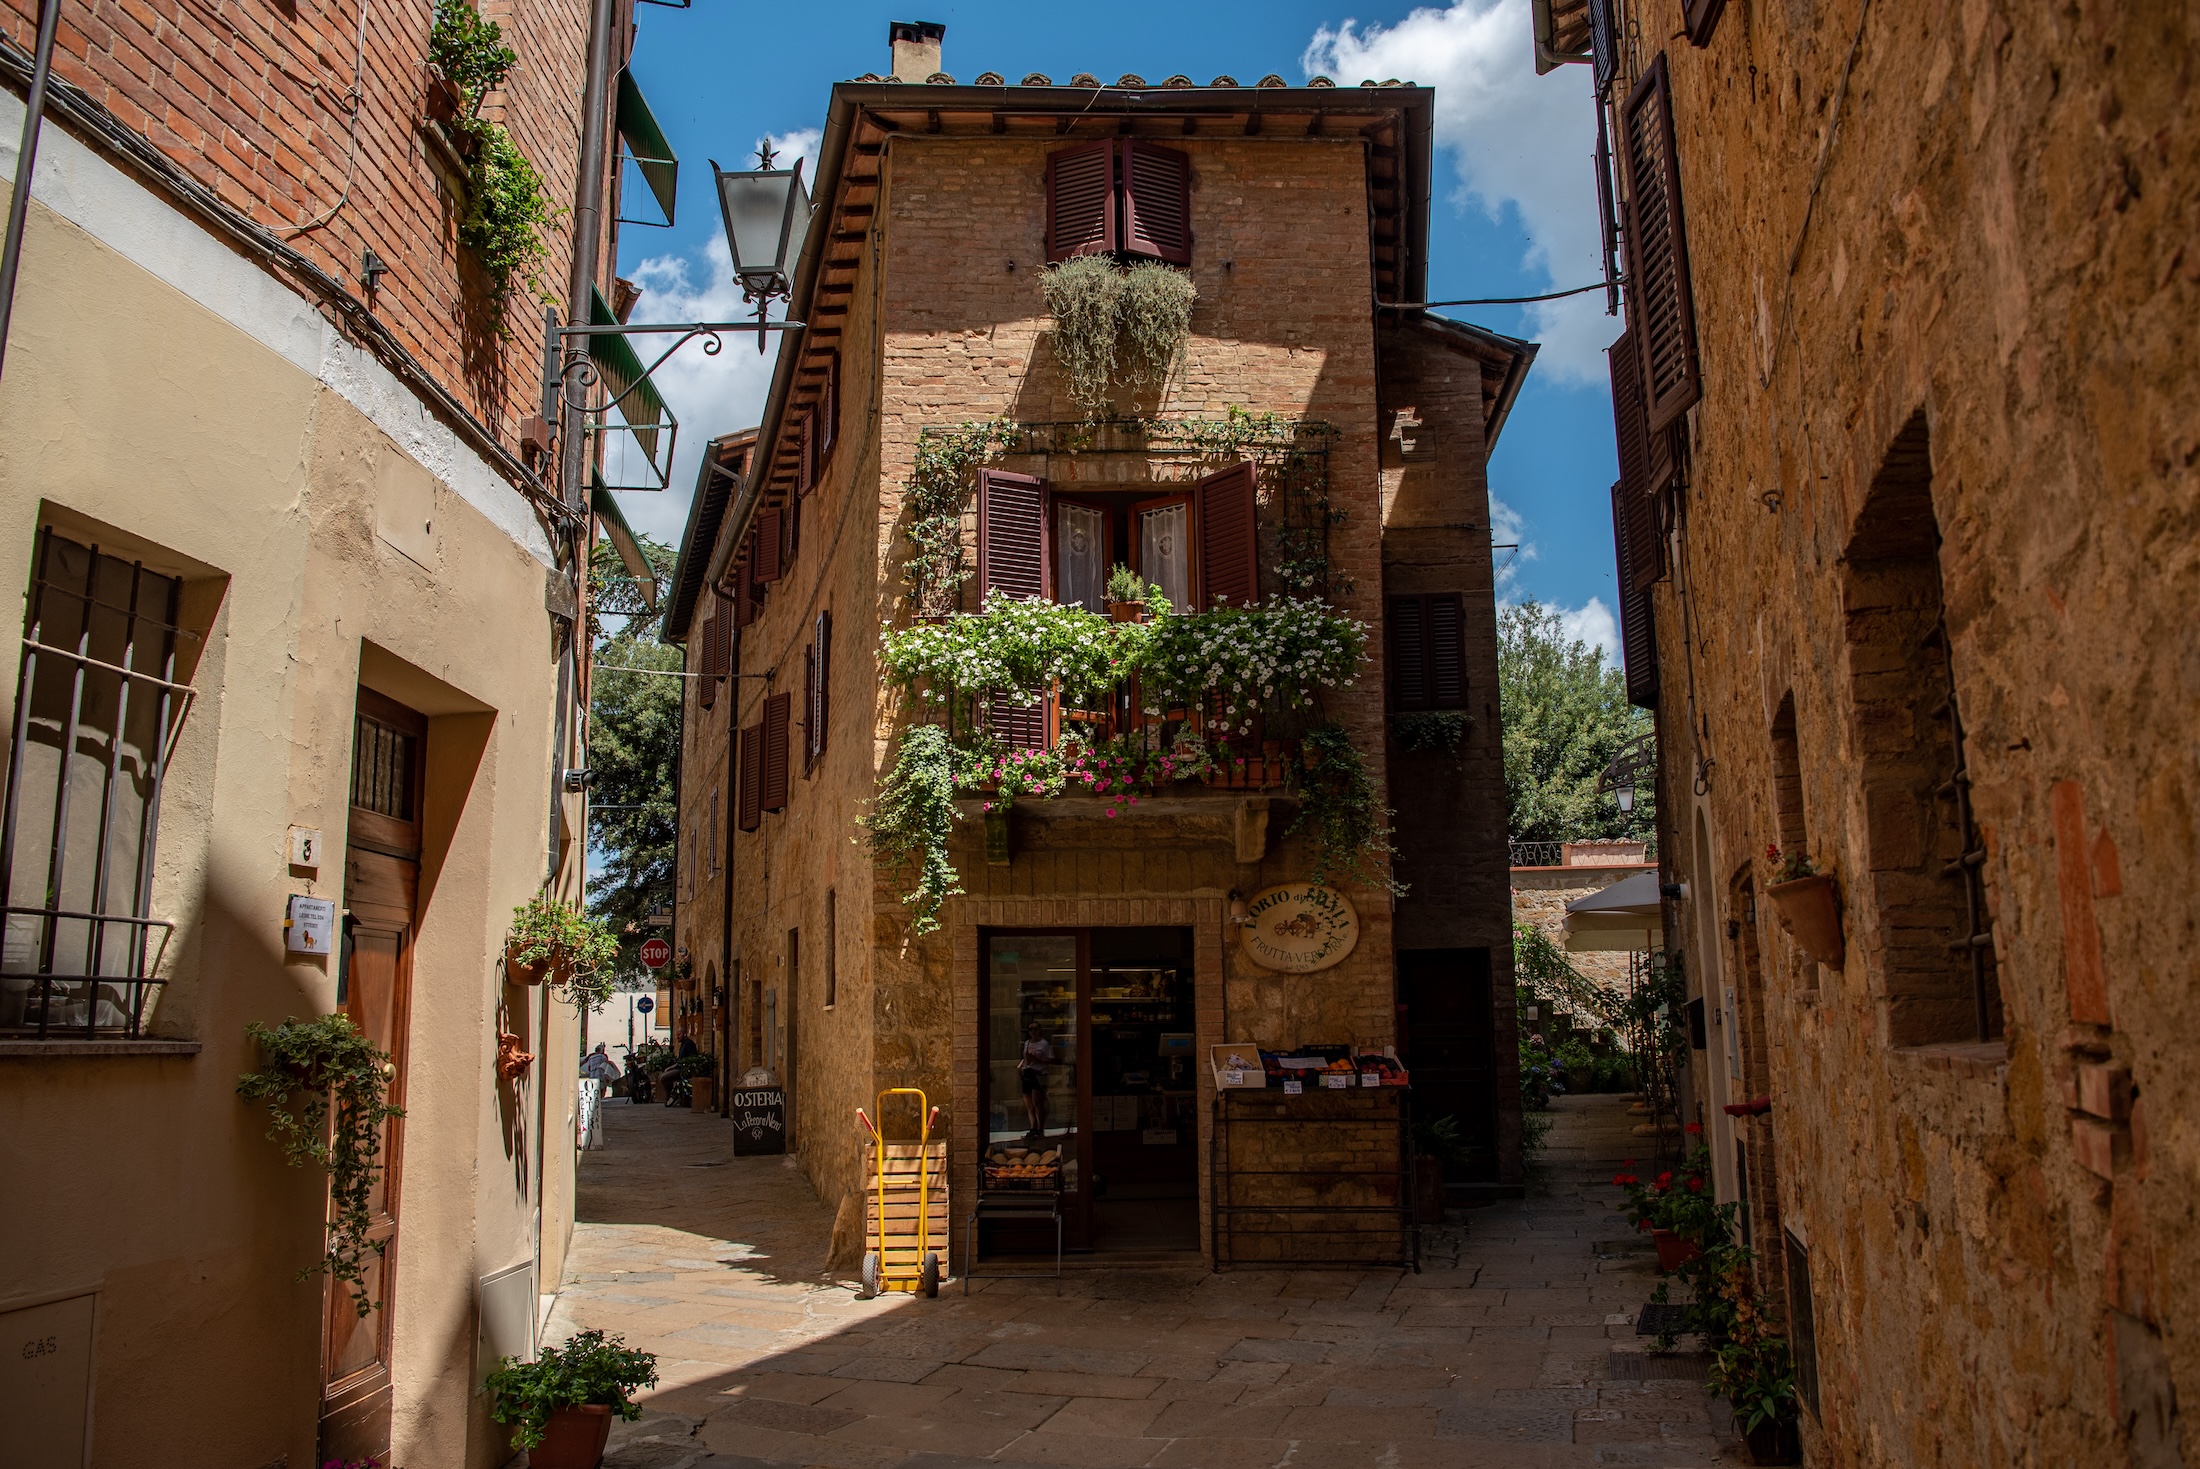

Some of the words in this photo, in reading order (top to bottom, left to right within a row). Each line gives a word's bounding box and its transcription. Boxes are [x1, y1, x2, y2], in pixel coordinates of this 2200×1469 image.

[303, 839, 312, 862] 3
[643, 948, 669, 960] STOP
[733, 1091, 783, 1108] OSTERIA
[733, 1119, 748, 1132] La
[744, 1110, 768, 1128] Pecora
[22, 1336, 57, 1360] GAS
